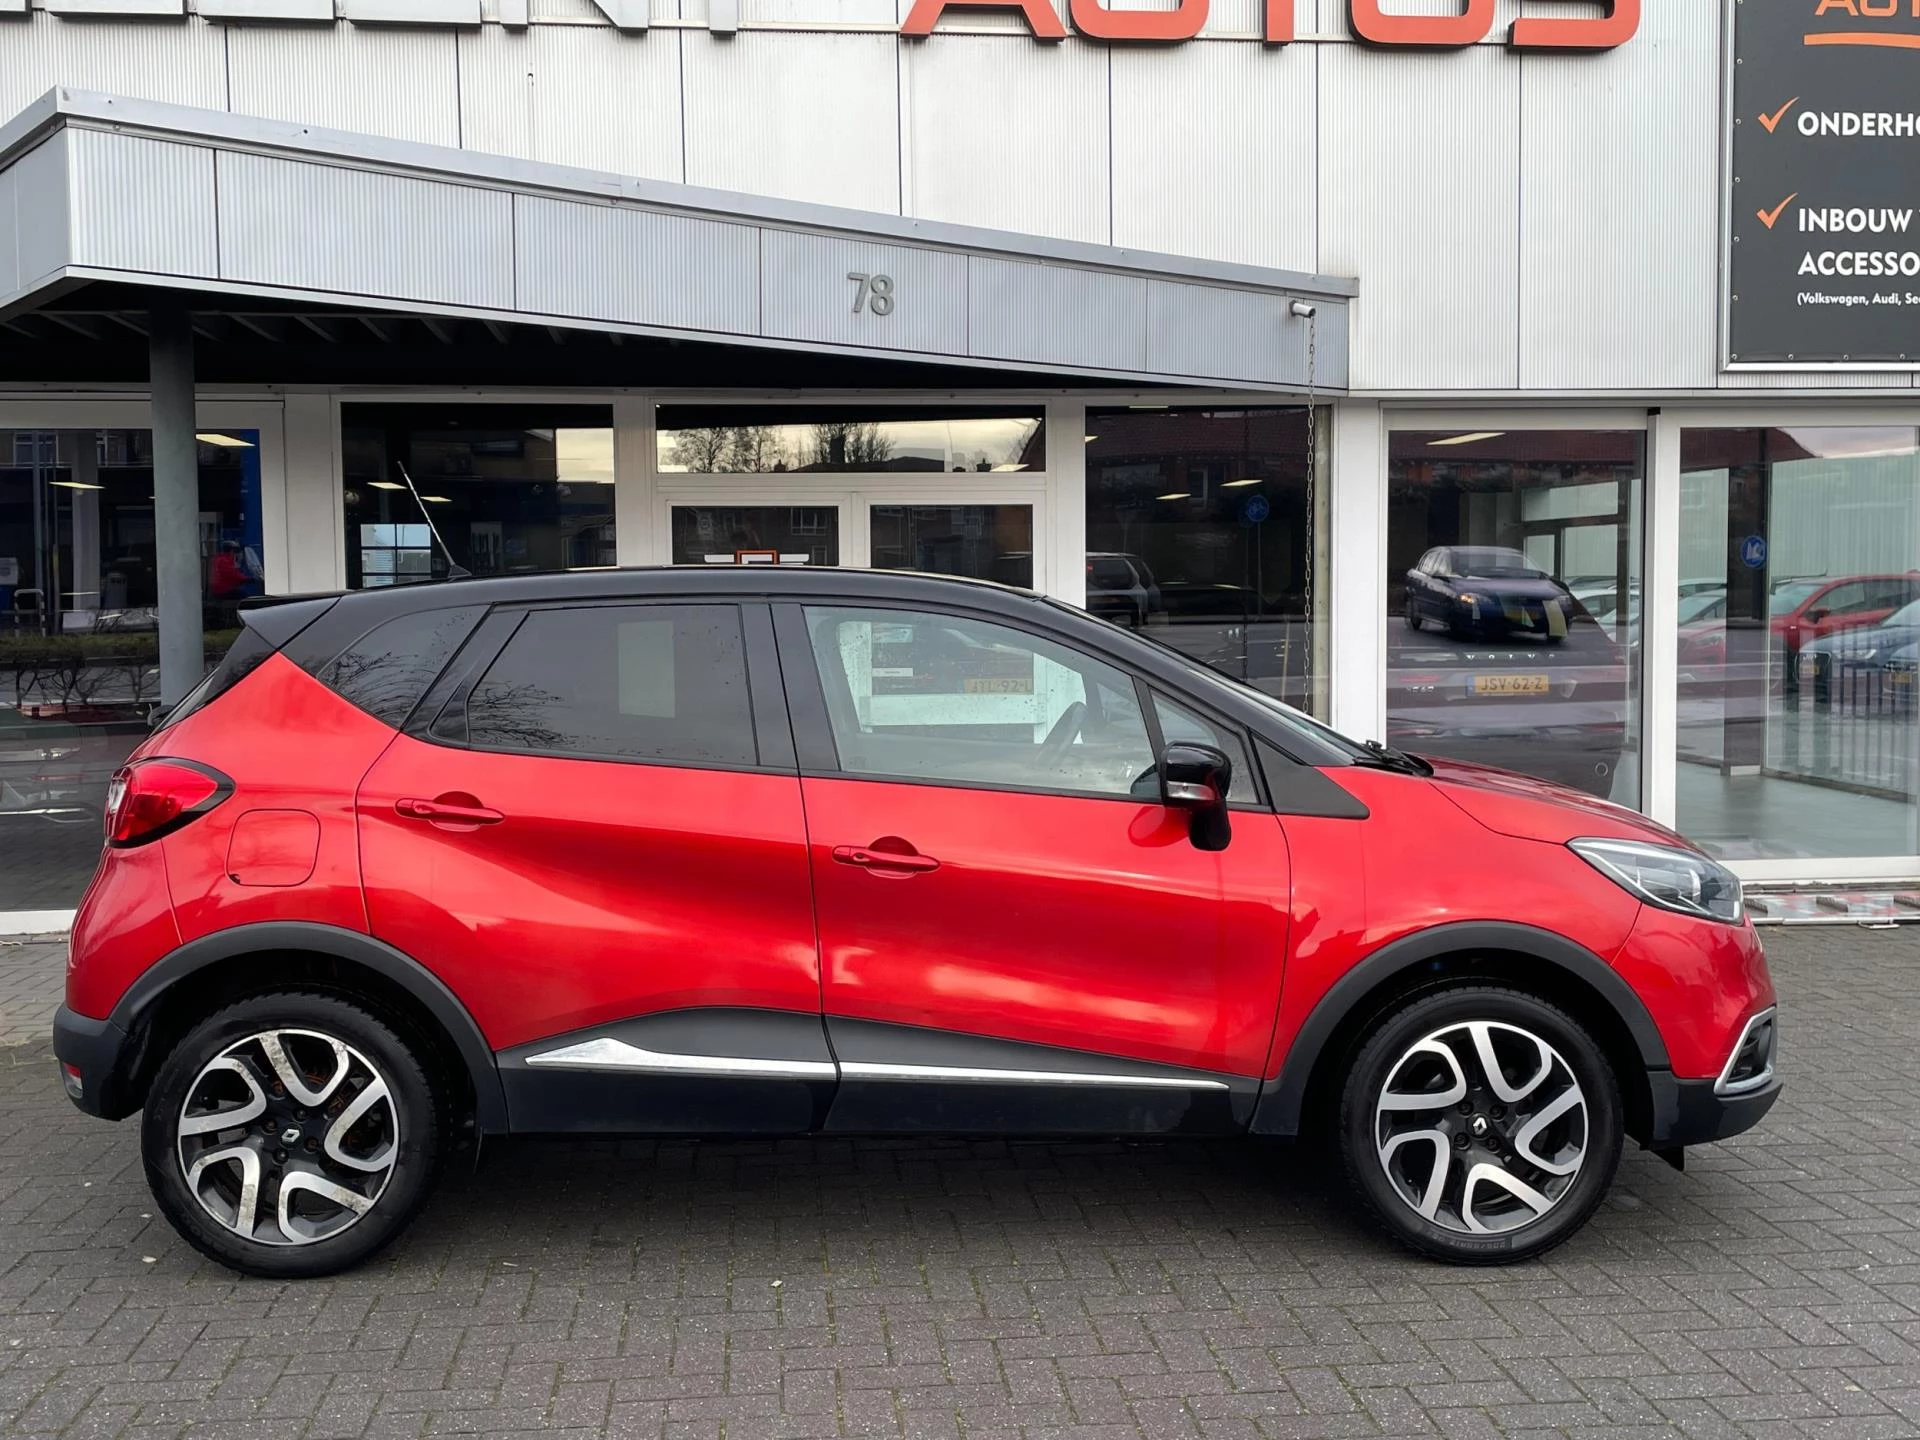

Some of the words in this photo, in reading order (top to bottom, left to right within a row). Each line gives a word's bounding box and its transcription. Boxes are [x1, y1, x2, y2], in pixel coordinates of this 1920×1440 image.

[1798, 111, 1920, 136] ONDERH
[1799, 208, 1913, 232] INBOUW
[1798, 251, 1920, 276] ACCESSO
[847, 272, 894, 316] 78
[1797, 292, 1869, 307] (Volkswagen,
[1872, 292, 1902, 306] Audi,
[1905, 292, 1920, 305] Se
[1480, 677, 1544, 691] JSV-62-Z
